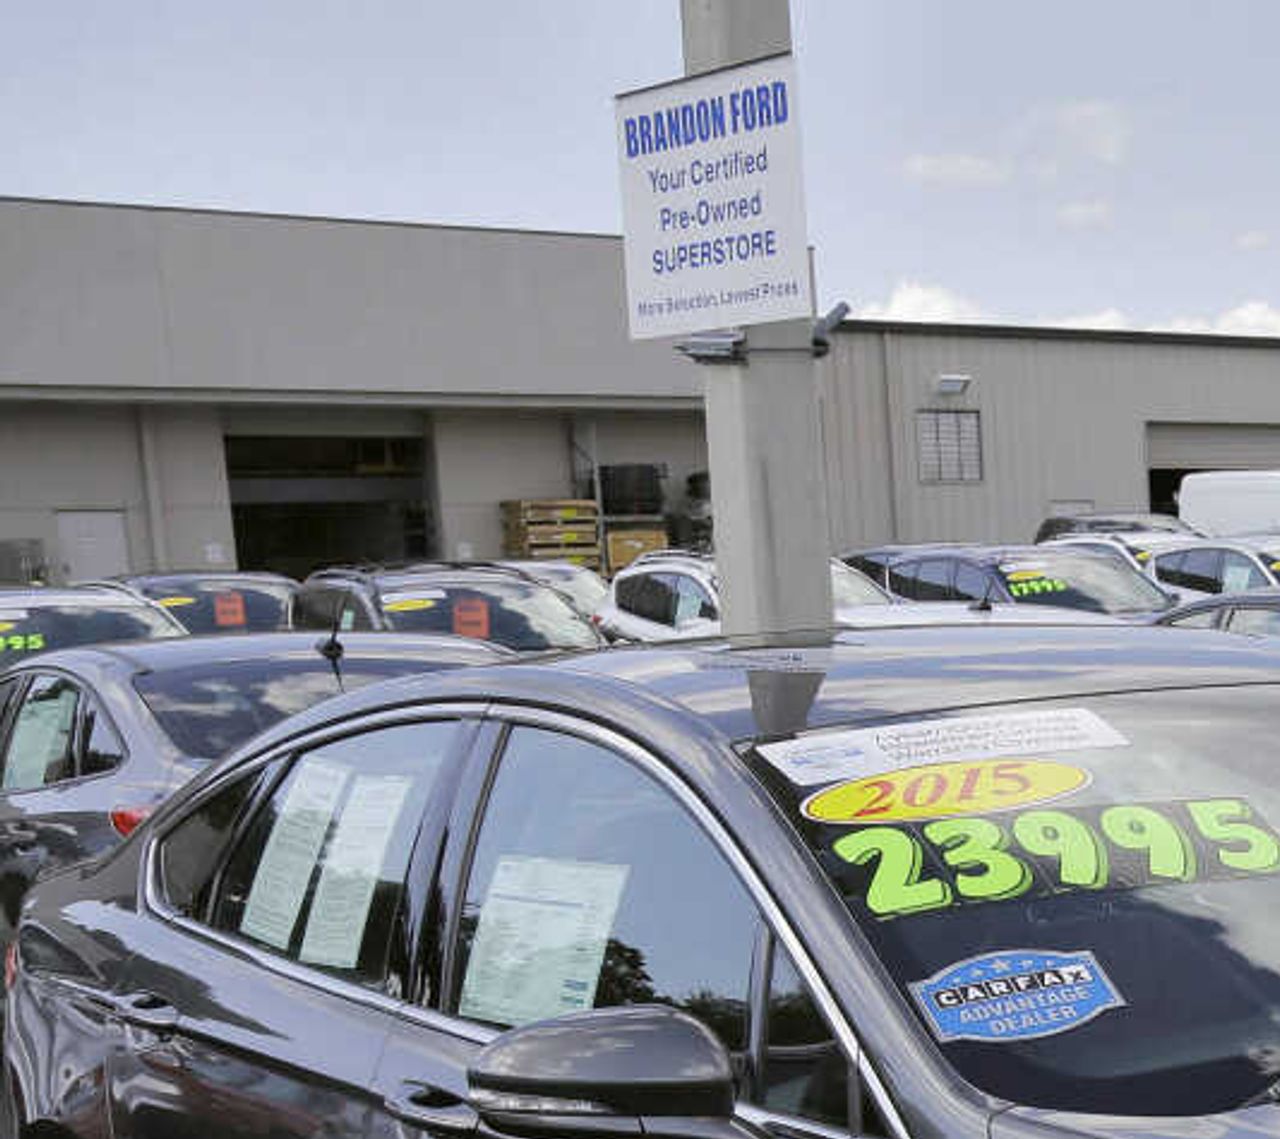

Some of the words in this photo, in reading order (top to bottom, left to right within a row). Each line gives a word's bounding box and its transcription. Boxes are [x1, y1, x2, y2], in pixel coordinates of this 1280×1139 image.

[624, 97, 726, 158] BRANDON
[731, 81, 789, 134] FORD
[648, 168, 686, 193] Your
[690, 149, 768, 186] Certified
[660, 193, 763, 231] Pre-Owned
[652, 231, 777, 274] SUPERSTORE
[853, 763, 1033, 817] 2015
[933, 965, 1093, 1010] CARFAX
[959, 987, 1091, 1025] ADVANTAGE
[990, 1004, 1078, 1035] DEALER
